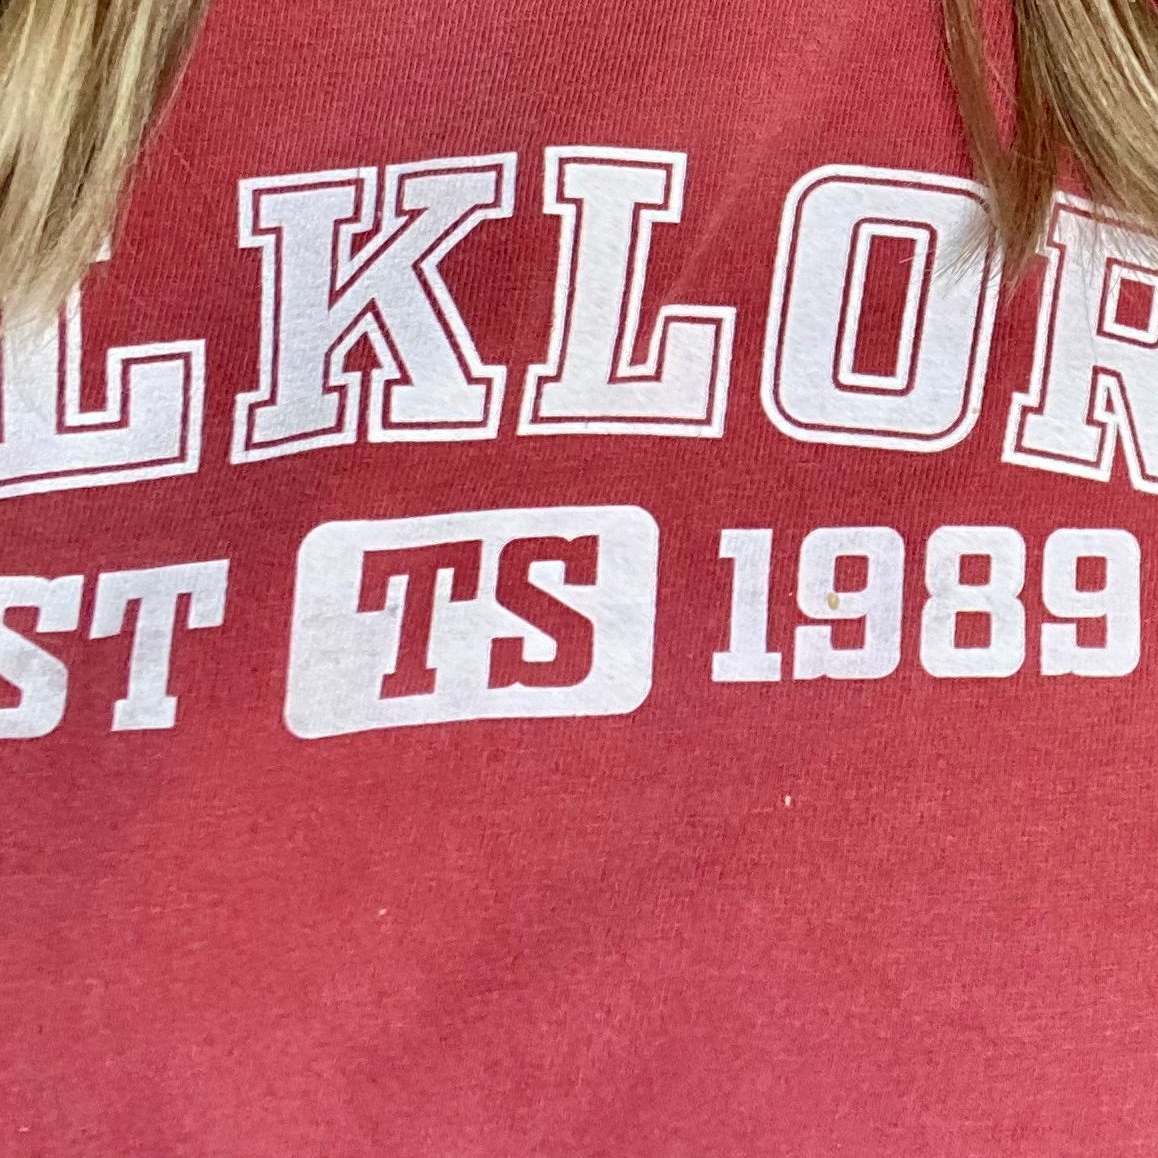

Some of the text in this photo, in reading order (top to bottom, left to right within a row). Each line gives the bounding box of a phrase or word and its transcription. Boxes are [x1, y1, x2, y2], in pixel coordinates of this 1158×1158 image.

[0, 525, 1141, 739] ST TS 1989
